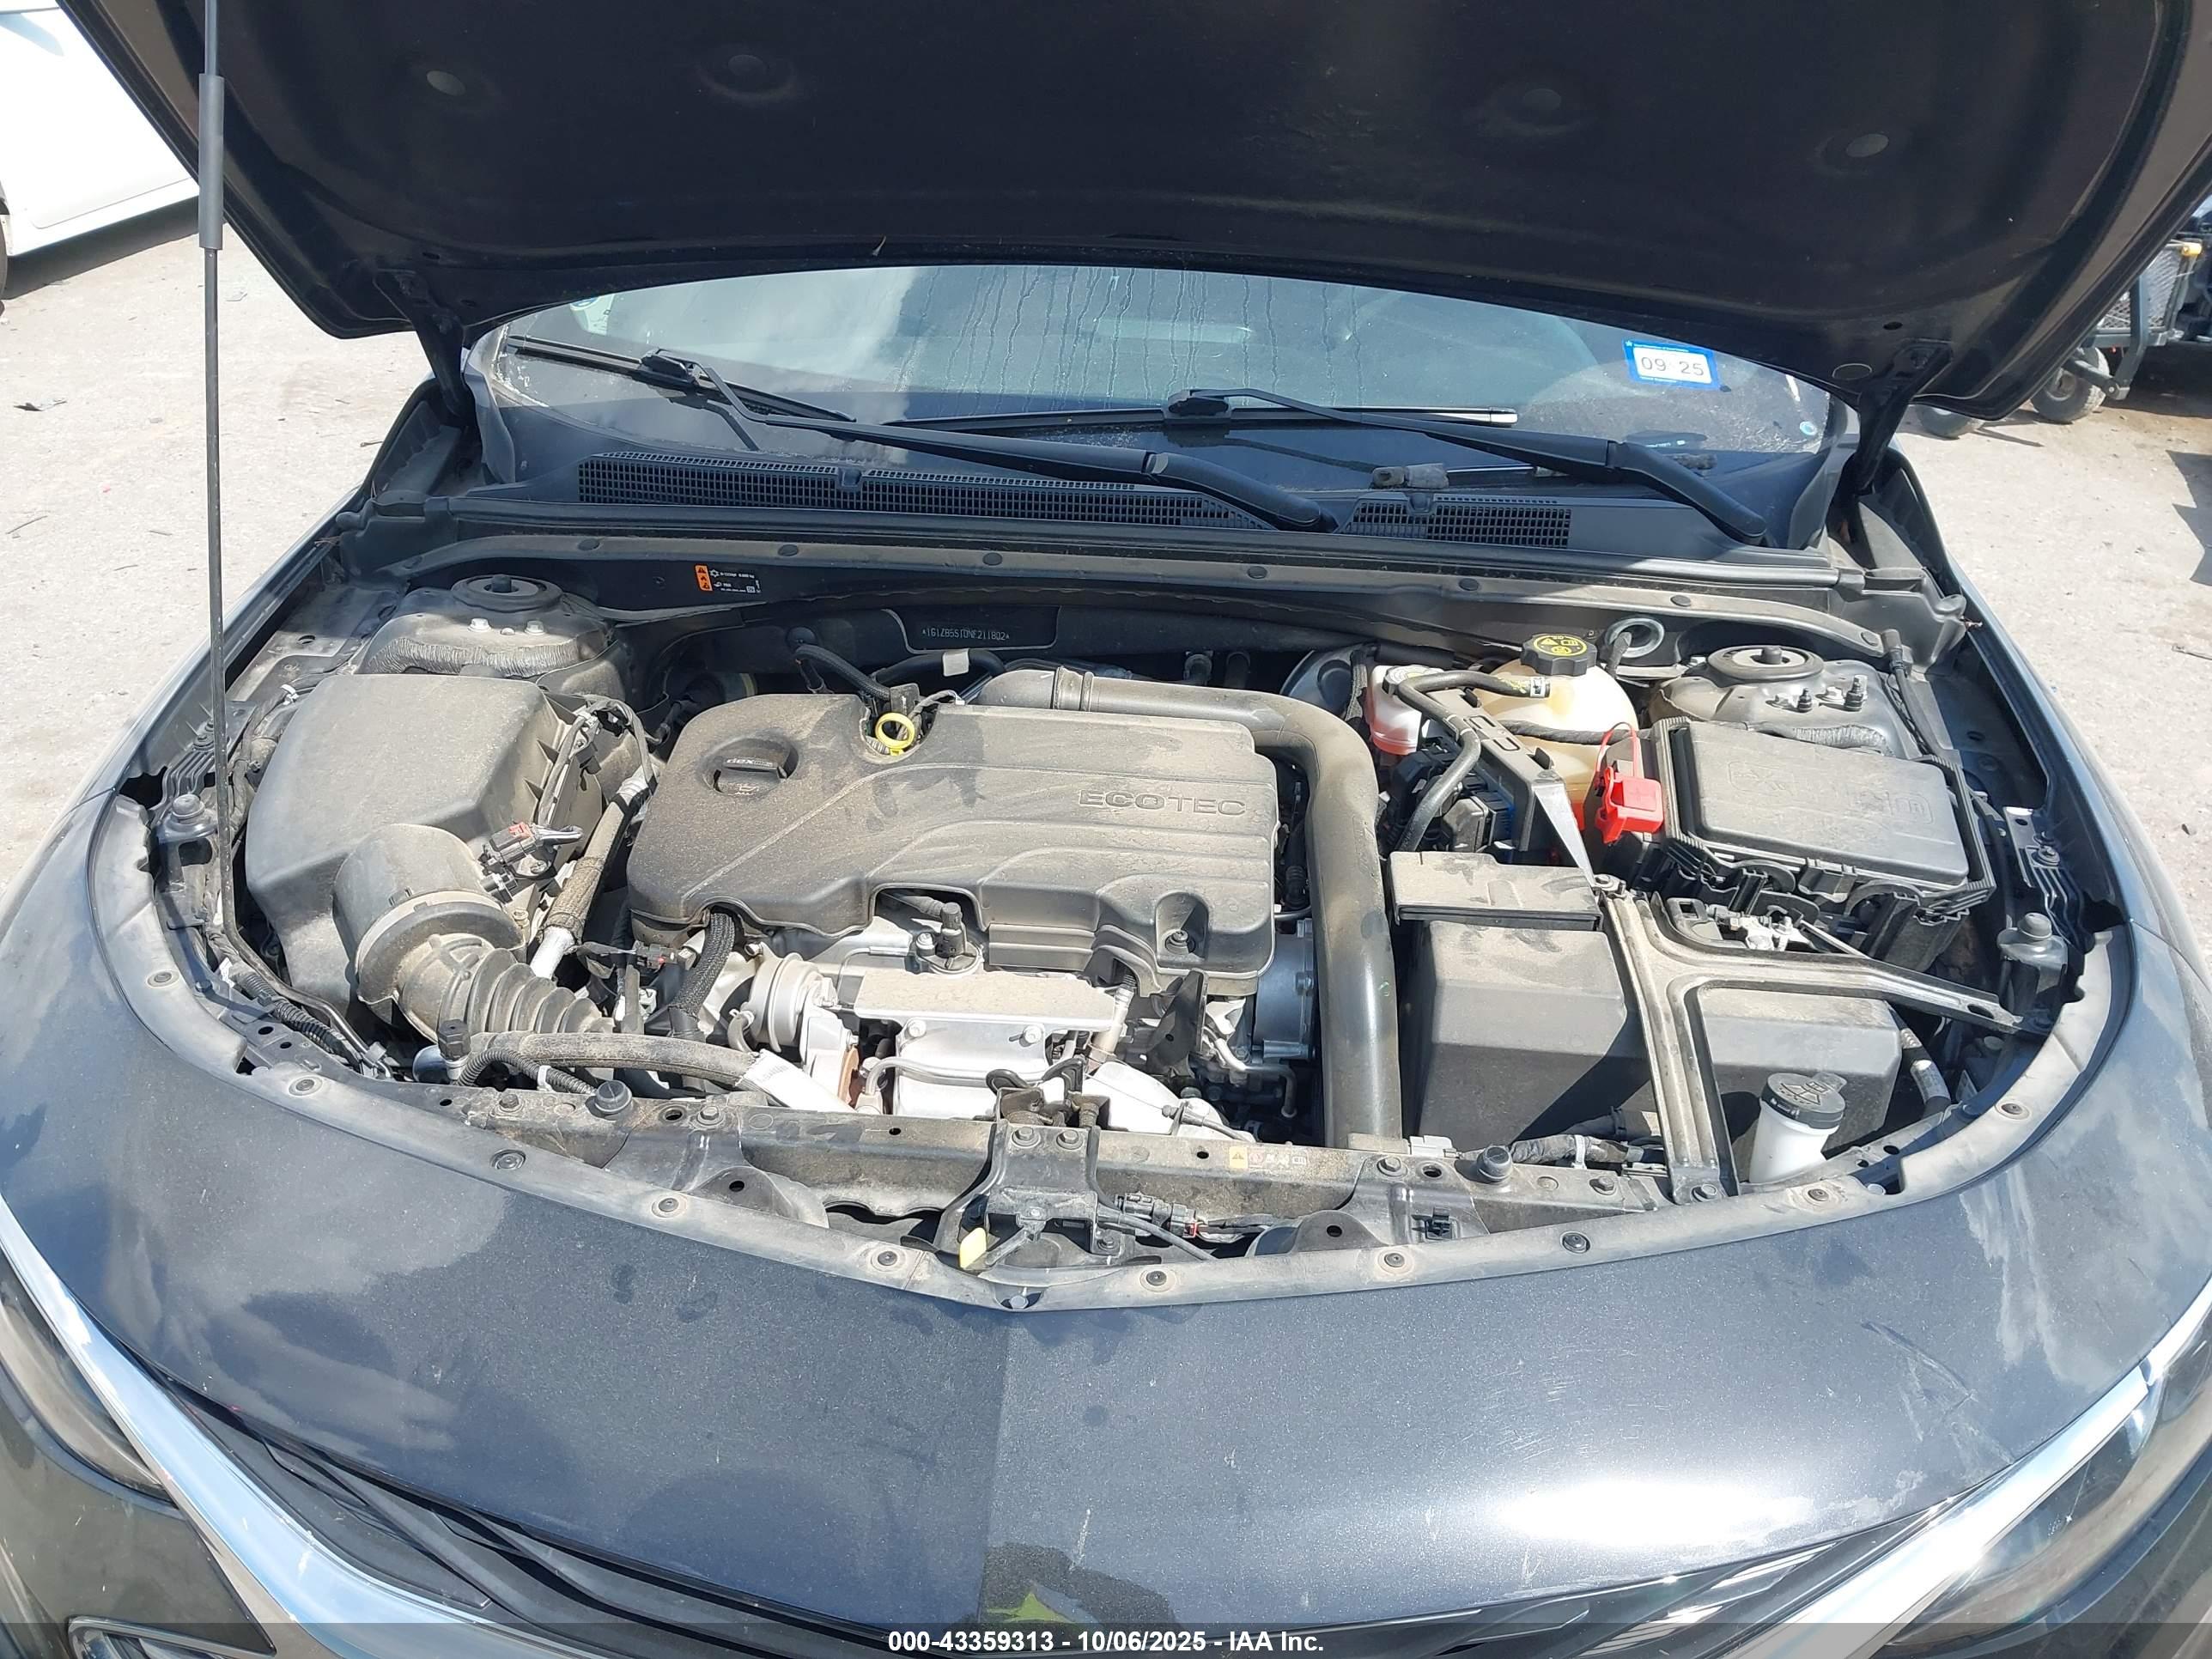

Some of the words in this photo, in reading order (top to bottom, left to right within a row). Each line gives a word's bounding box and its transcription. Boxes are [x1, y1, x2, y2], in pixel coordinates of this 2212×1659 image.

[1641, 356, 1666, 372] 09
[1679, 361, 1705, 376] 25
[1079, 789, 1246, 816] ECOTEC
